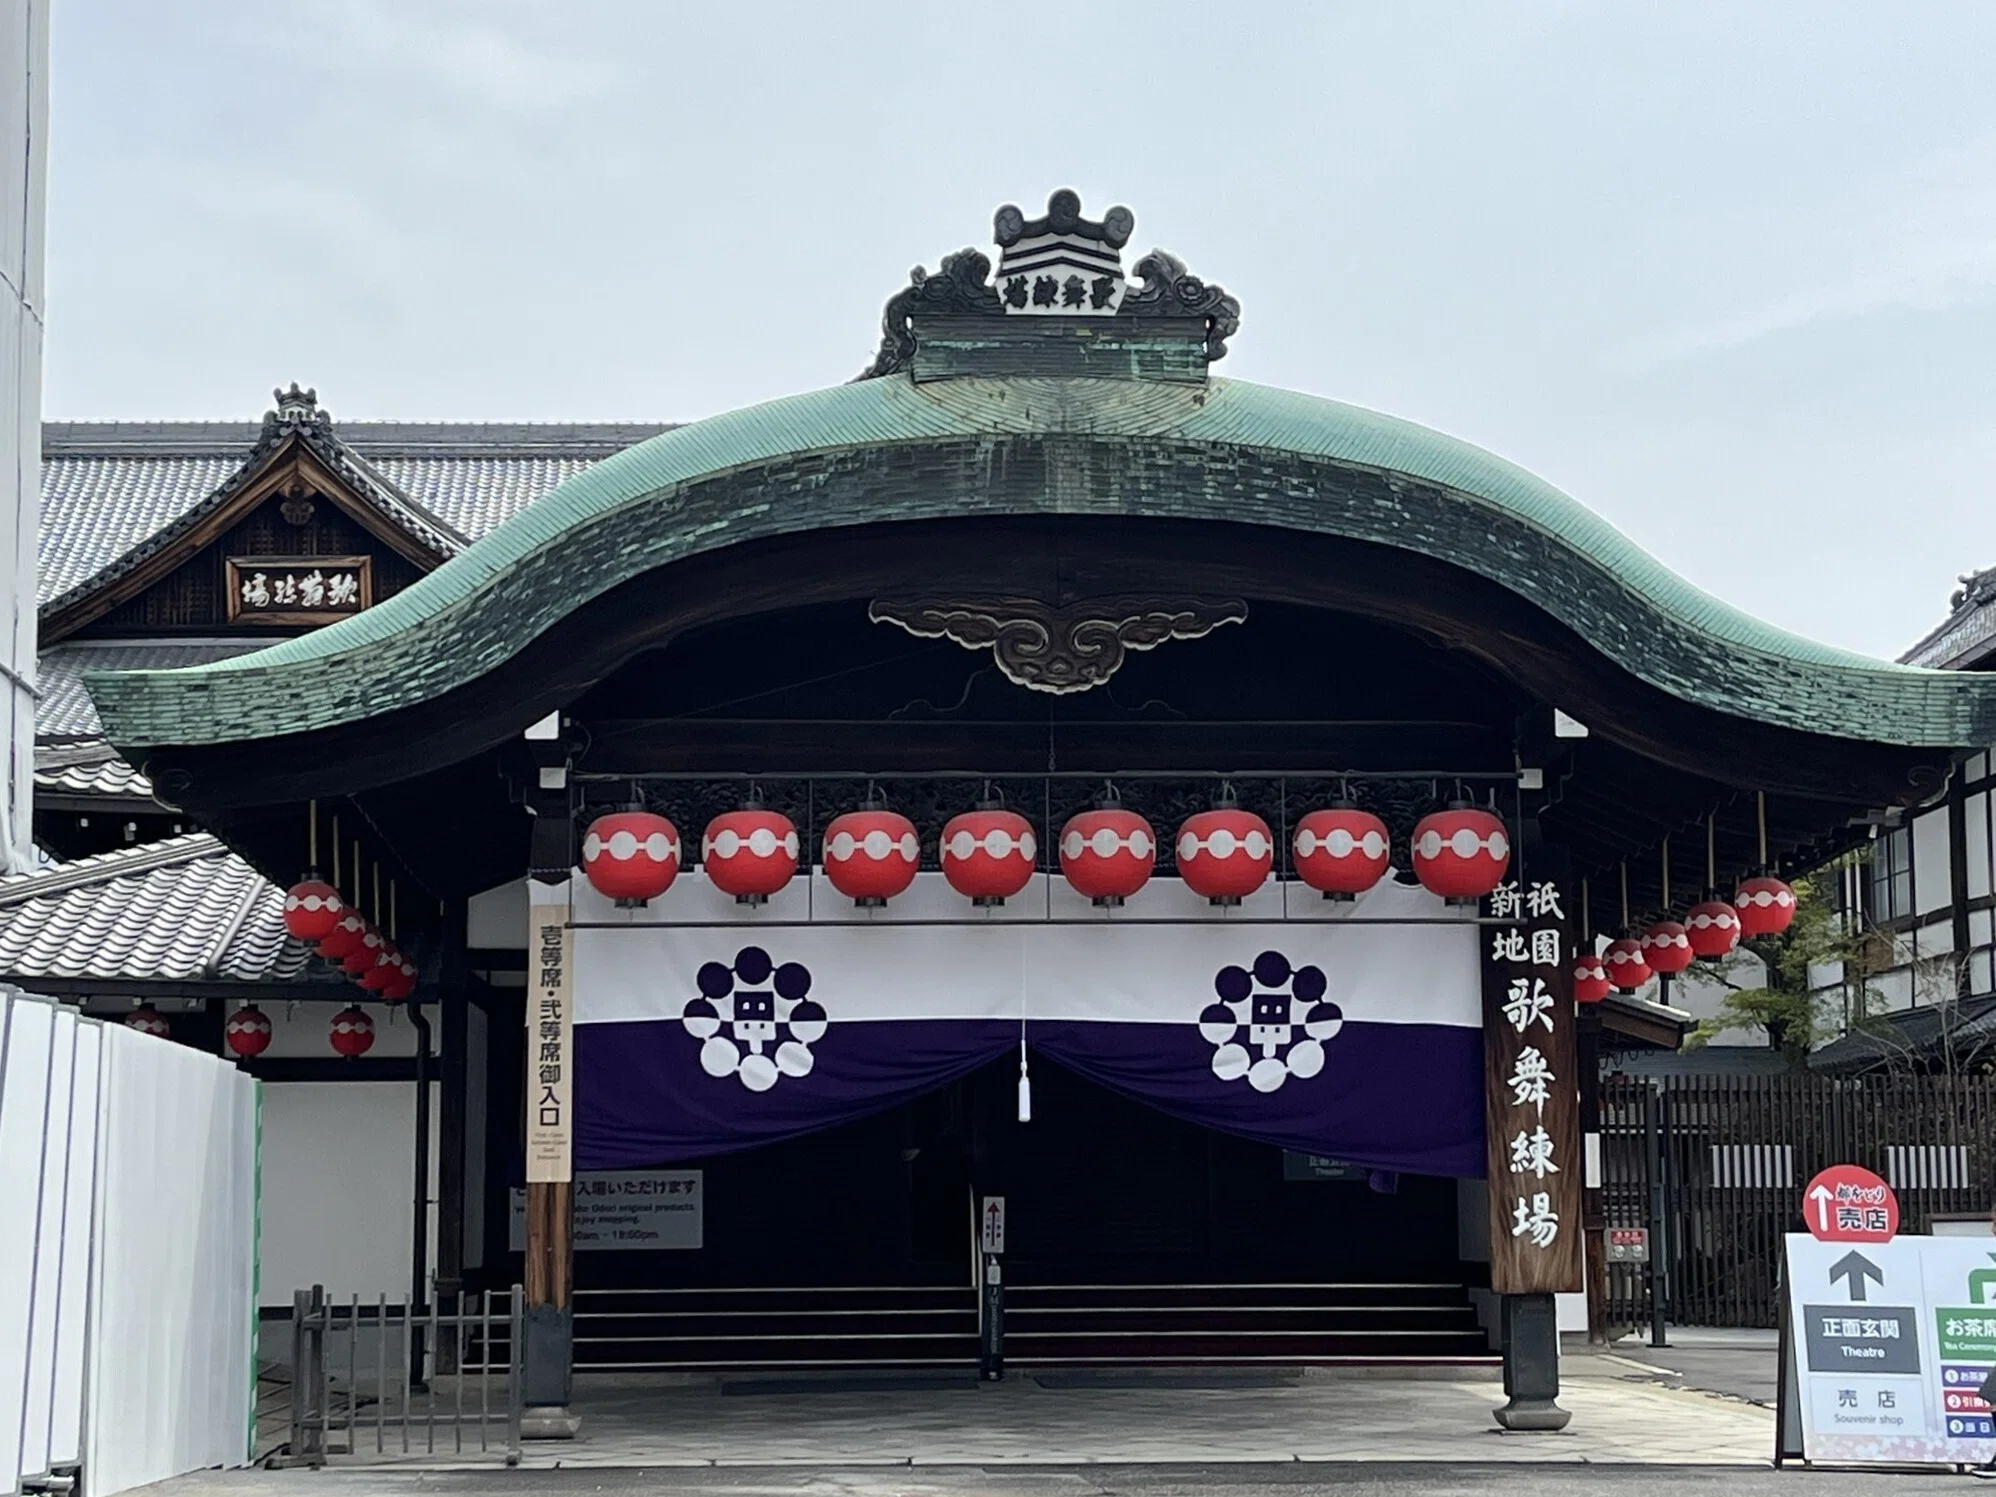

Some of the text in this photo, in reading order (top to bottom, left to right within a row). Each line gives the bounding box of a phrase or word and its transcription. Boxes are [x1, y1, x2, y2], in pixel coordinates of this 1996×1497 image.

[1501, 978, 1560, 1249] 歌舞練場
[1838, 1208, 1887, 1230] 売店
[1822, 1318, 1900, 1339] 正面玄関
[1841, 1346, 1886, 1358] Theatre
[1879, 1415, 1904, 1426] shop
